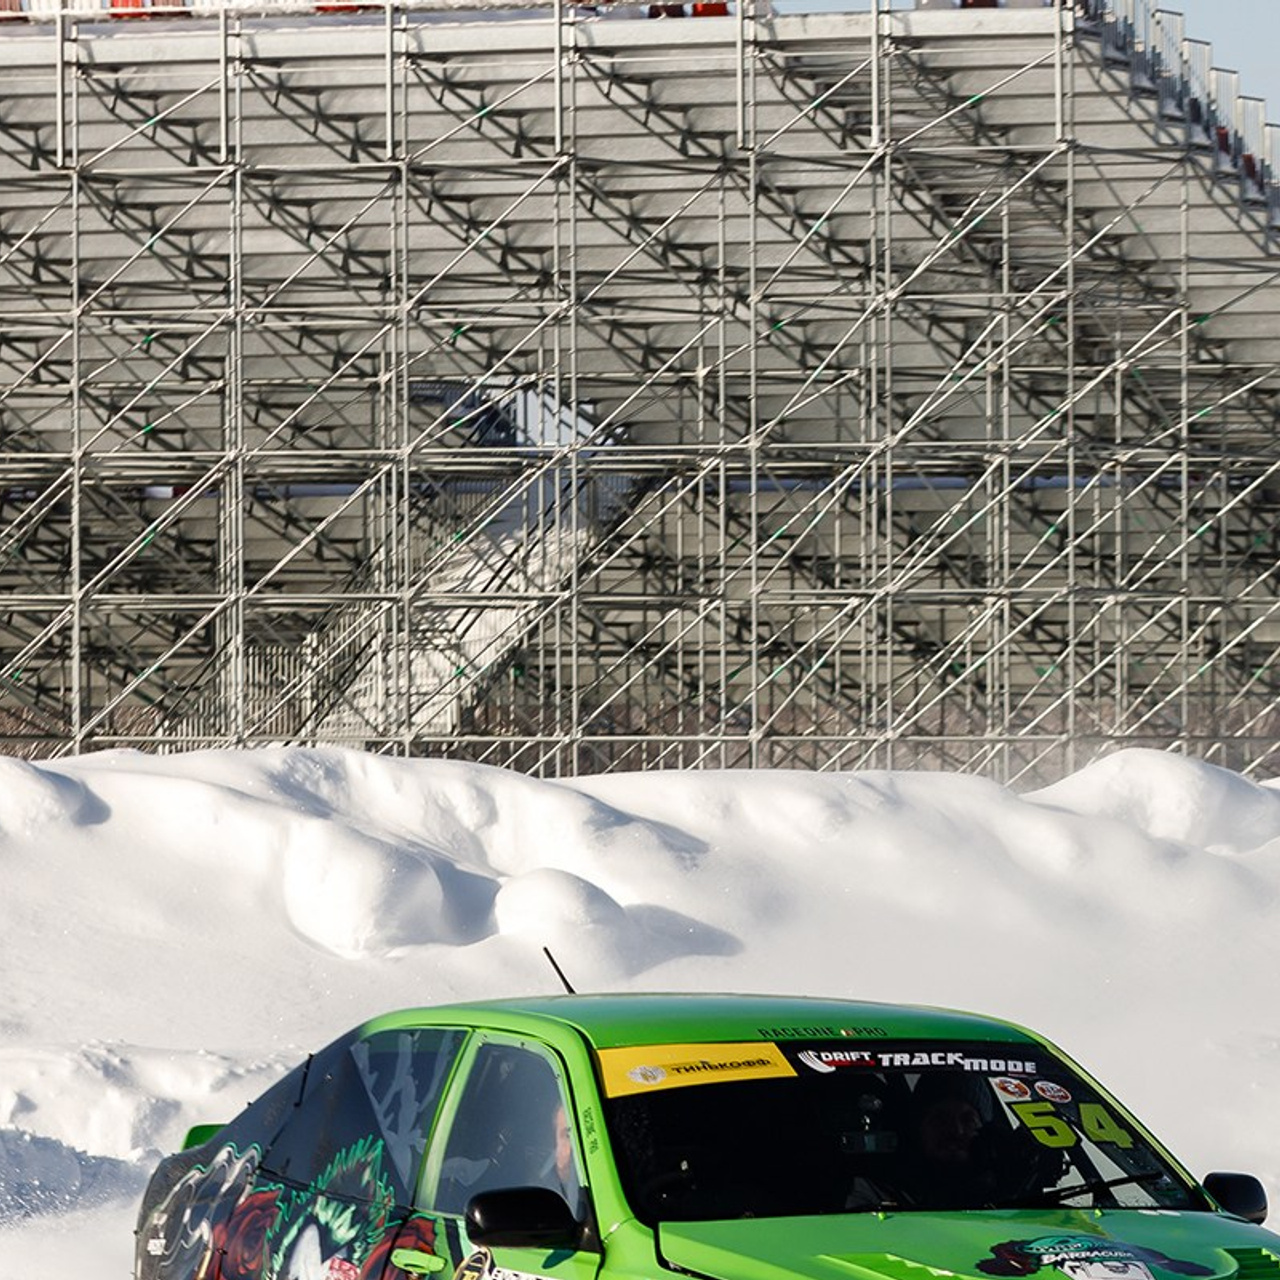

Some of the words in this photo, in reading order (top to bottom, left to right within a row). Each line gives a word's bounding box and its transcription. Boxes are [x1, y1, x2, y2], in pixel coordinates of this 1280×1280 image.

[758, 1027, 836, 1038] RACEONE
[857, 1027, 888, 1037] PRO
[820, 1051, 872, 1062] DRIFT
[1010, 1102, 1134, 1149] 54
